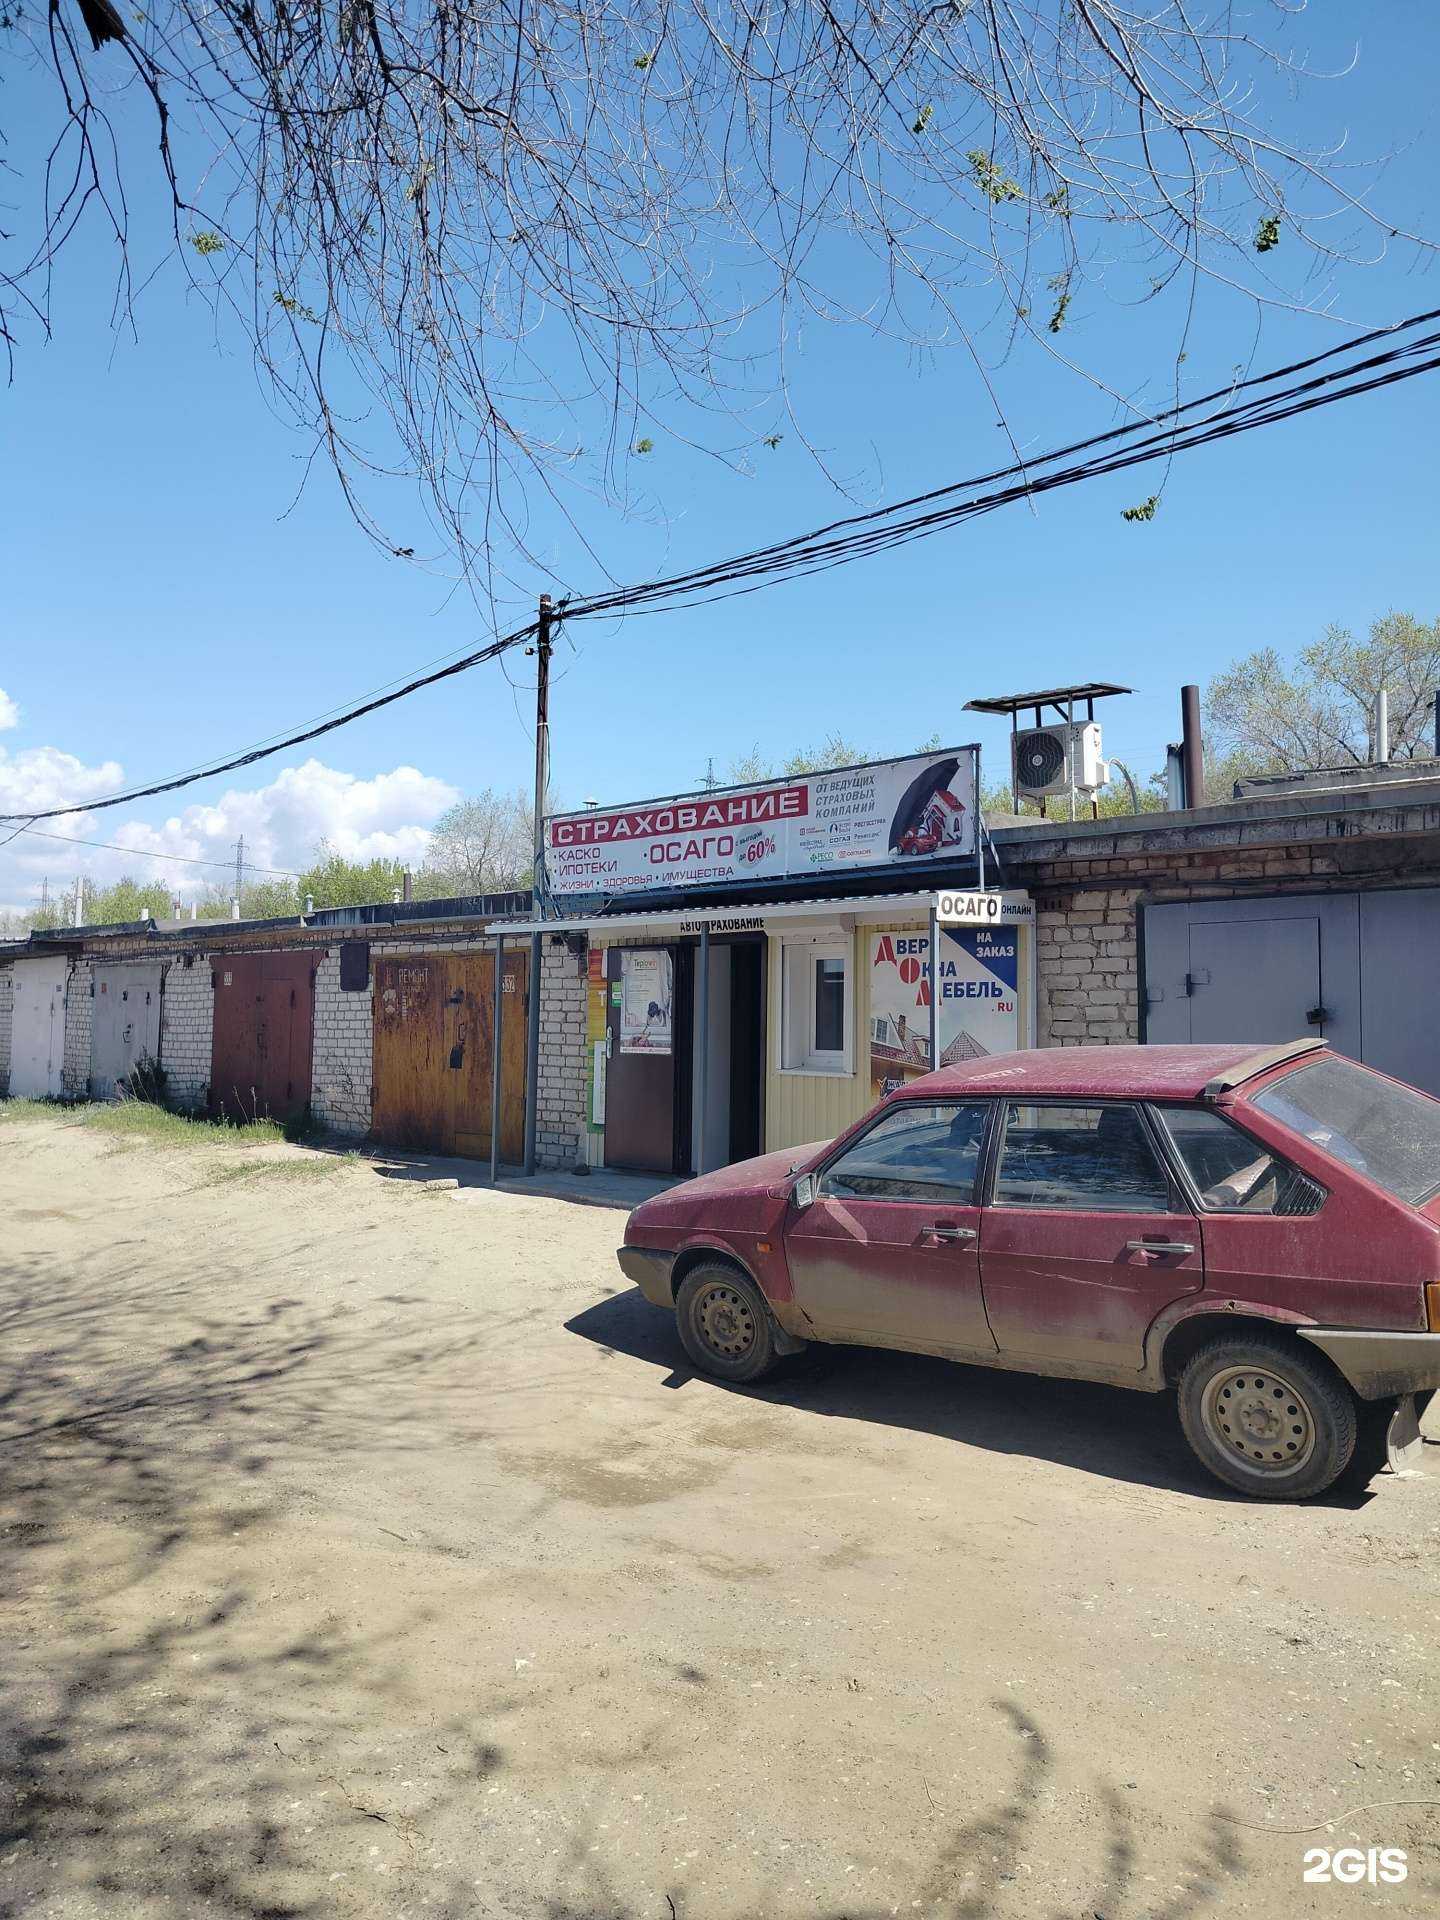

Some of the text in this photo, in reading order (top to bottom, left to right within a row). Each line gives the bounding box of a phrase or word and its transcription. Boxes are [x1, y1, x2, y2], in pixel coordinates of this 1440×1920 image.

[815, 775, 876, 794] ОТ ВЕДУЩИХ
[815, 788, 875, 806] СТРАХОВЫХ
[557, 791, 800, 844] СТРАХОВАНИЕ
[815, 800, 876, 818] КОМПАНИЙ
[747, 834, 776, 862] 60%
[829, 835, 851, 844] СОГАЗ
[558, 847, 601, 862] КАСКО
[650, 835, 734, 864] ОСАГО
[559, 861, 617, 876] ИПОТЕКИ
[560, 866, 735, 890] ЖИЗНИ ЗДОРОВЬЯ ИМУЩЕСТВА
[941, 895, 998, 917] ОСАГО
[1001, 904, 1032, 915] ОНЛАЙН
[680, 917, 765, 933] АВТОРАХОВАНИЕ
[976, 931, 993, 943] НА
[874, 936, 940, 967] ДВЕР
[976, 945, 1015, 958] ЗАКАЗ
[915, 979, 1003, 1006] МЕБЕЛЬ
